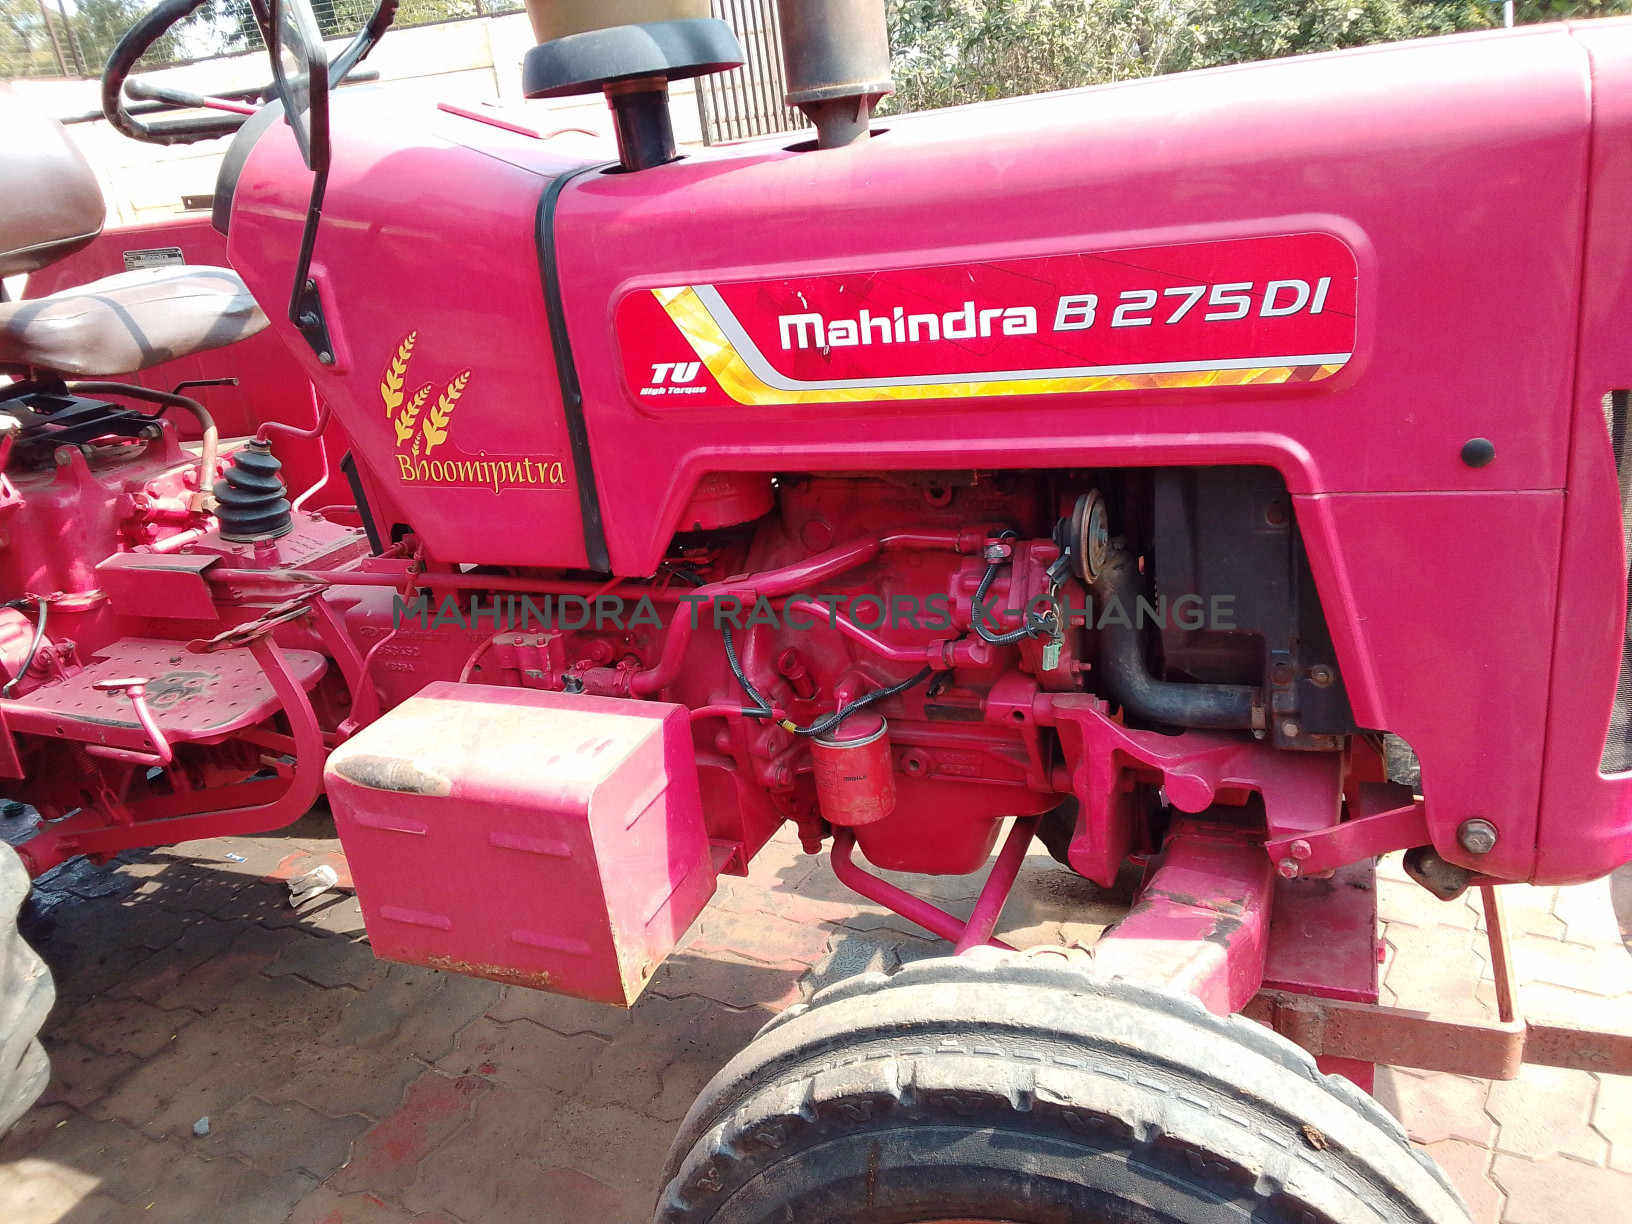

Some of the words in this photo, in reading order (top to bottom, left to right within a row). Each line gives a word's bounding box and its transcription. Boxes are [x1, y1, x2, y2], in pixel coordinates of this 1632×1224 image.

[778, 301, 1038, 350] Mahindra
[1053, 293, 1098, 331] B
[651, 361, 702, 384] TU
[639, 387, 667, 396] High
[667, 386, 707, 395] Torque
[395, 453, 566, 494] Bhoomiputra
